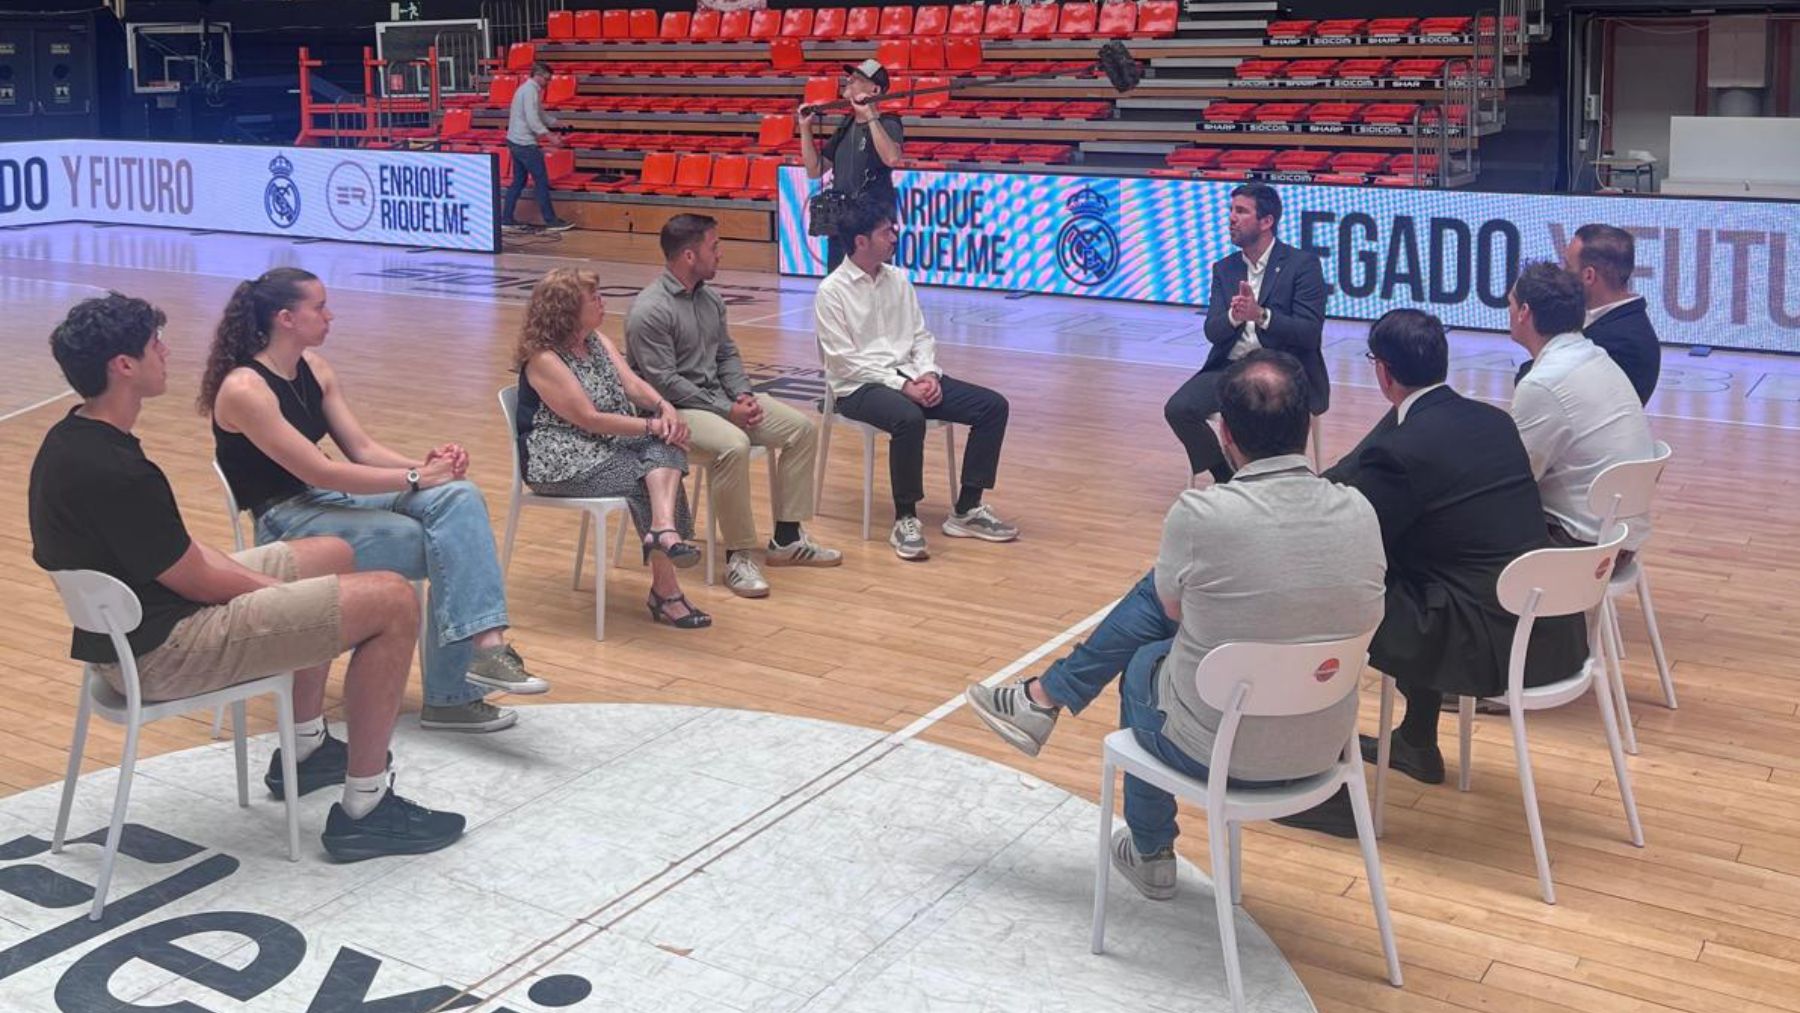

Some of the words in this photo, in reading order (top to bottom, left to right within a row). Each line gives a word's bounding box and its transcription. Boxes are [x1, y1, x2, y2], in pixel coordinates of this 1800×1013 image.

[0, 157, 48, 213] DO
[61, 155, 82, 208] Y
[89, 155, 194, 215] FUTURO
[379, 164, 455, 199] ENRIQUE
[381, 199, 470, 235] RIQUELME
[895, 186, 984, 229] NRIQUE
[895, 231, 1005, 276] IQUELME
[1302, 210, 1520, 309] EGADO
